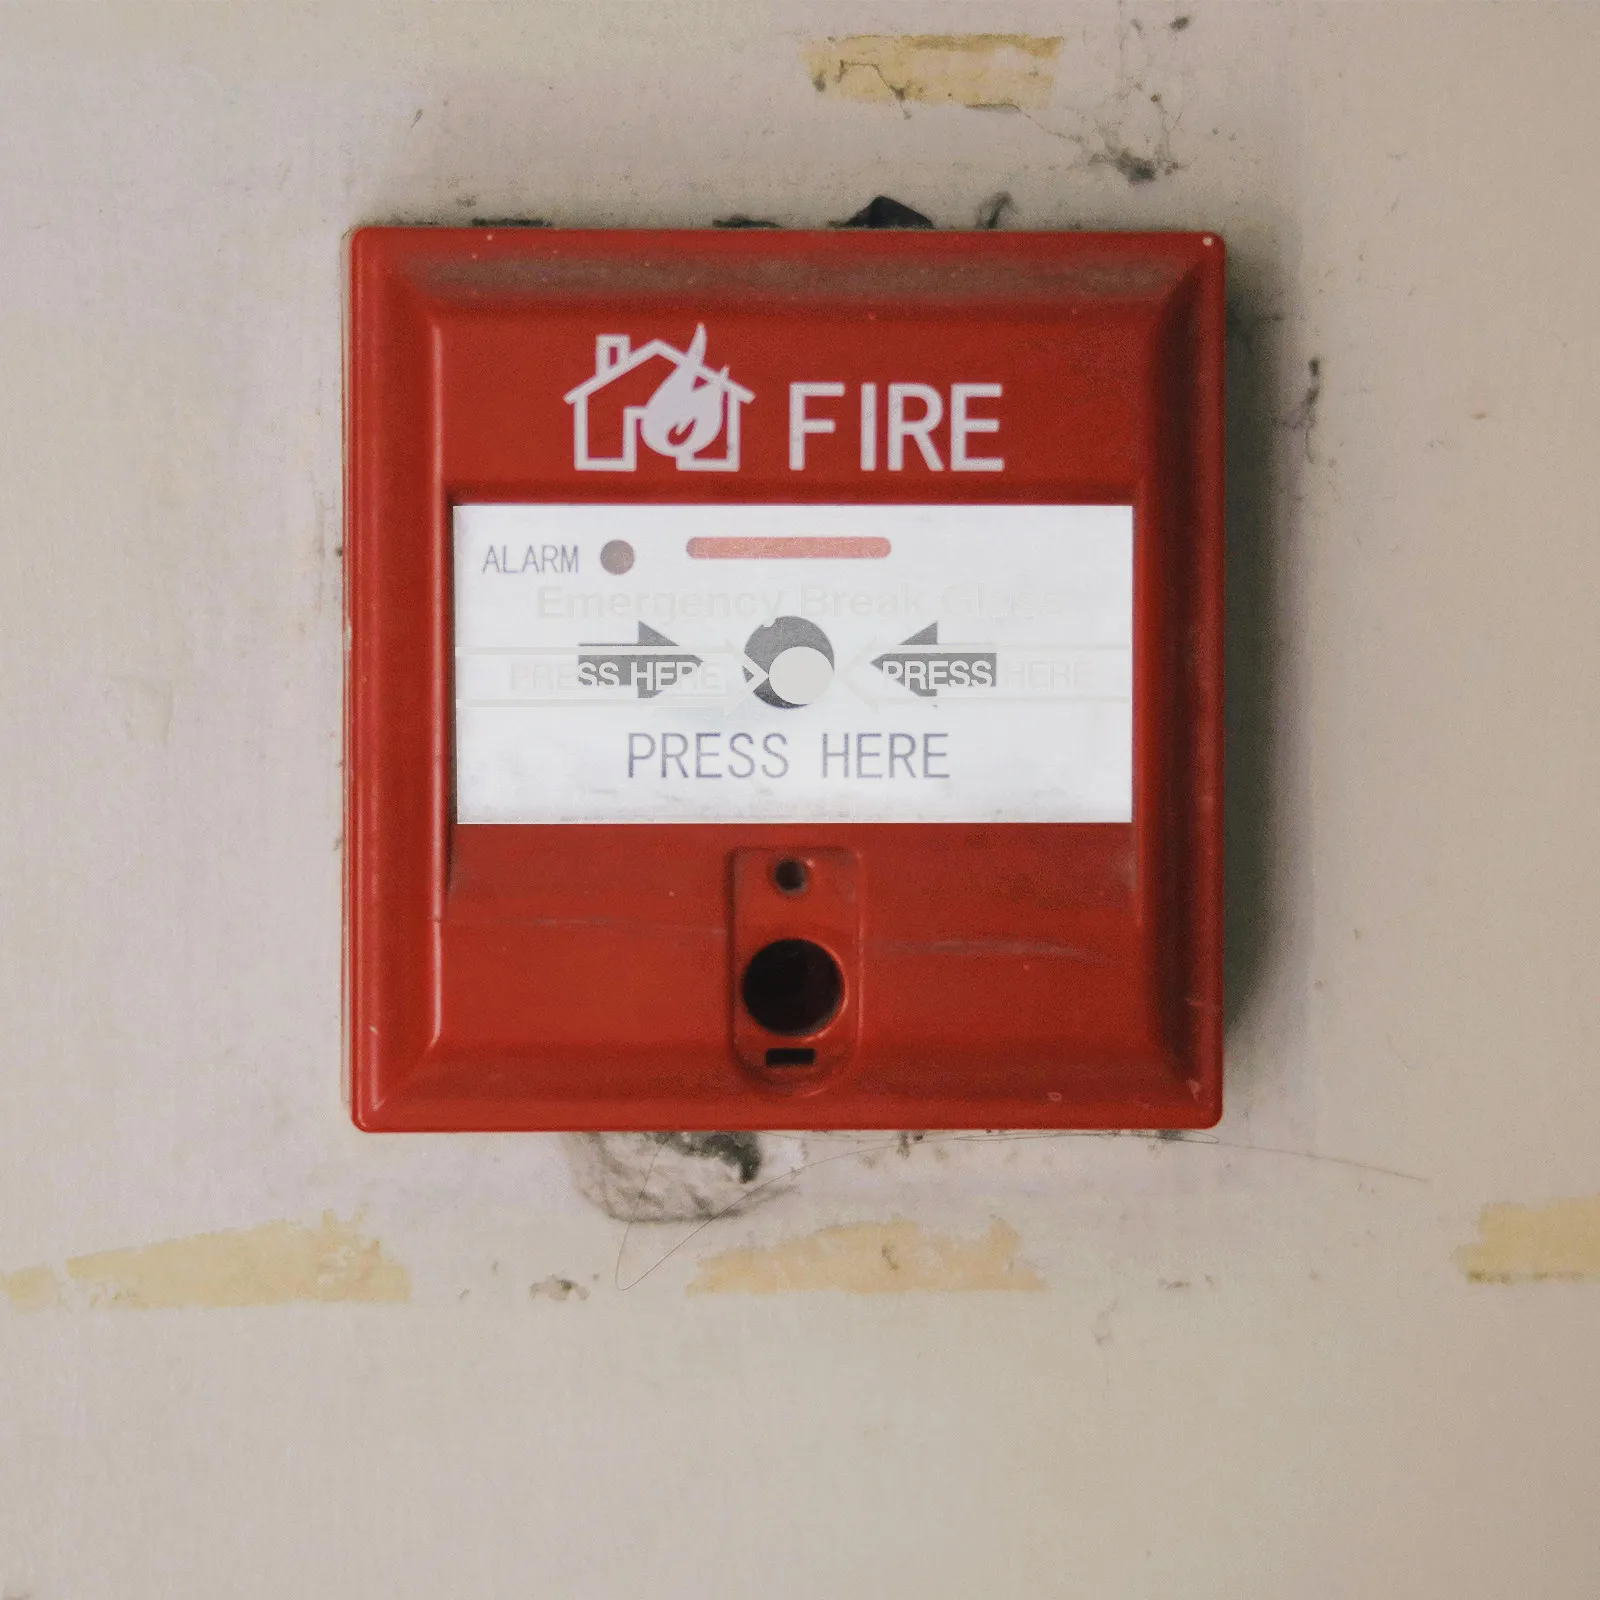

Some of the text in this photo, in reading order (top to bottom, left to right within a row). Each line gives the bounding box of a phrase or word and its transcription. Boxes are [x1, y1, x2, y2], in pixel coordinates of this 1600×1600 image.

[789, 383, 1004, 471] FIRE
[482, 544, 579, 573] ALARM
[537, 585, 785, 625] Emergency
[800, 583, 922, 618] Break
[509, 661, 726, 691] PRESS HERE
[882, 660, 1093, 690] PRESS HERE
[627, 732, 950, 779] PRESS HERE
